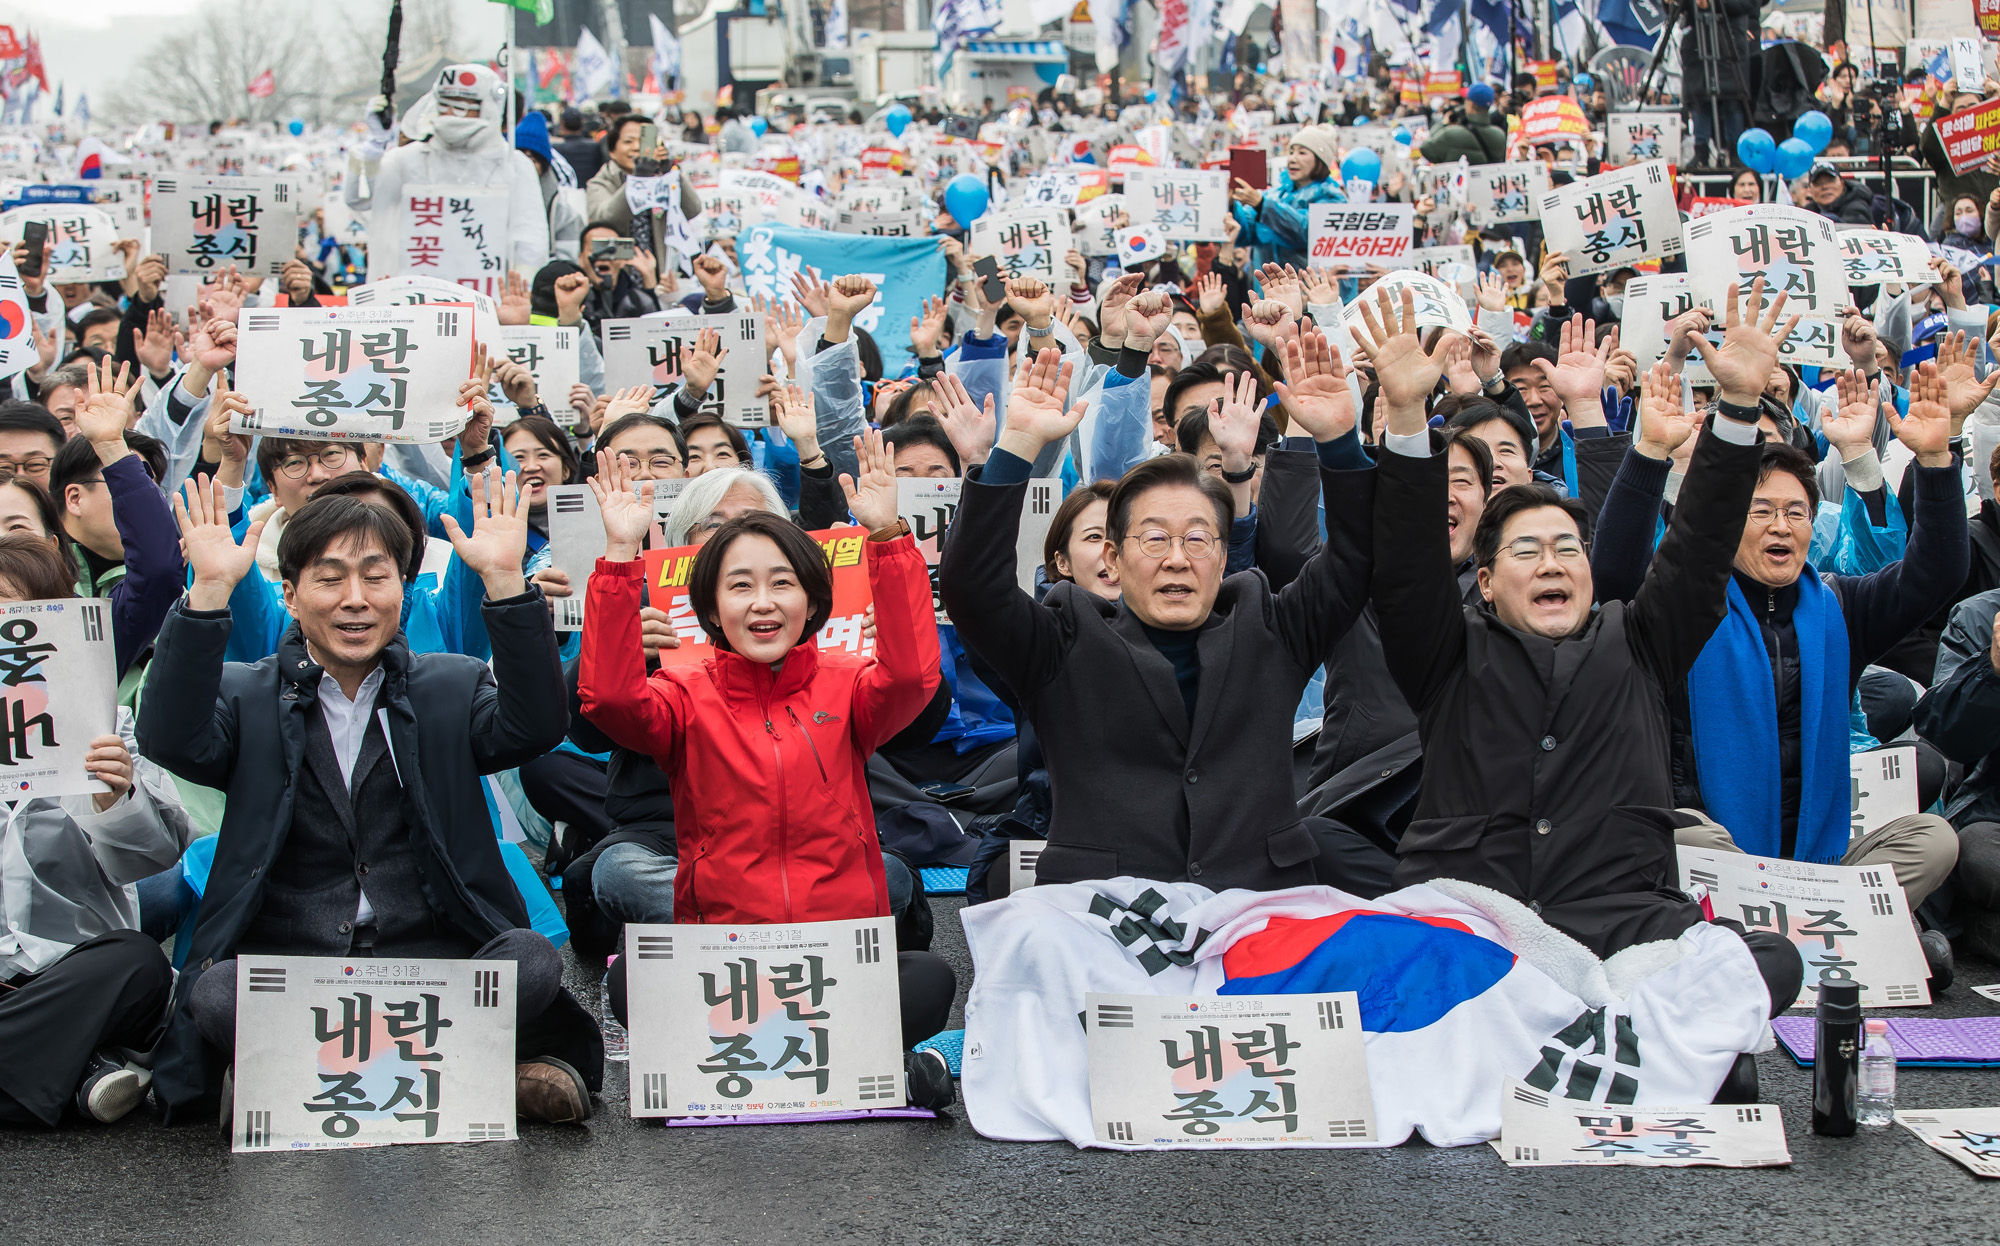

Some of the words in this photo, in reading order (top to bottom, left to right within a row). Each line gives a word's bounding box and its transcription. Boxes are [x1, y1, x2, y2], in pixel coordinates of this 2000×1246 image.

[1942, 113, 1975, 138] 윤석열
[1950, 135, 1982, 157] 국힘당
[1152, 182, 1203, 206] 내란
[1490, 173, 1530, 195] 내란
[190, 193, 263, 230] 내란
[1151, 208, 1200, 232] 종식
[1323, 212, 1400, 231] 국힘당을
[1574, 184, 1642, 225] 내란
[186, 233, 258, 269] 종식
[998, 220, 1053, 249] 내란
[1312, 236, 1410, 257] 해산하라!
[1581, 220, 1648, 264] 종식
[1728, 224, 1816, 268] 내란
[1003, 249, 1053, 279] 종식
[1842, 256, 1904, 280] 종식
[299, 327, 418, 374] 내란
[291, 377, 407, 431] 종식
[698, 955, 837, 1025] 내란
[310, 991, 453, 1063] 내란
[697, 1026, 830, 1099] 종식
[1159, 1023, 1301, 1082] 내란
[303, 1068, 441, 1139] 종식
[1162, 1082, 1298, 1136] 종식
[1574, 1114, 1717, 1140] 민주
[1572, 1140, 1720, 1160] 수호
